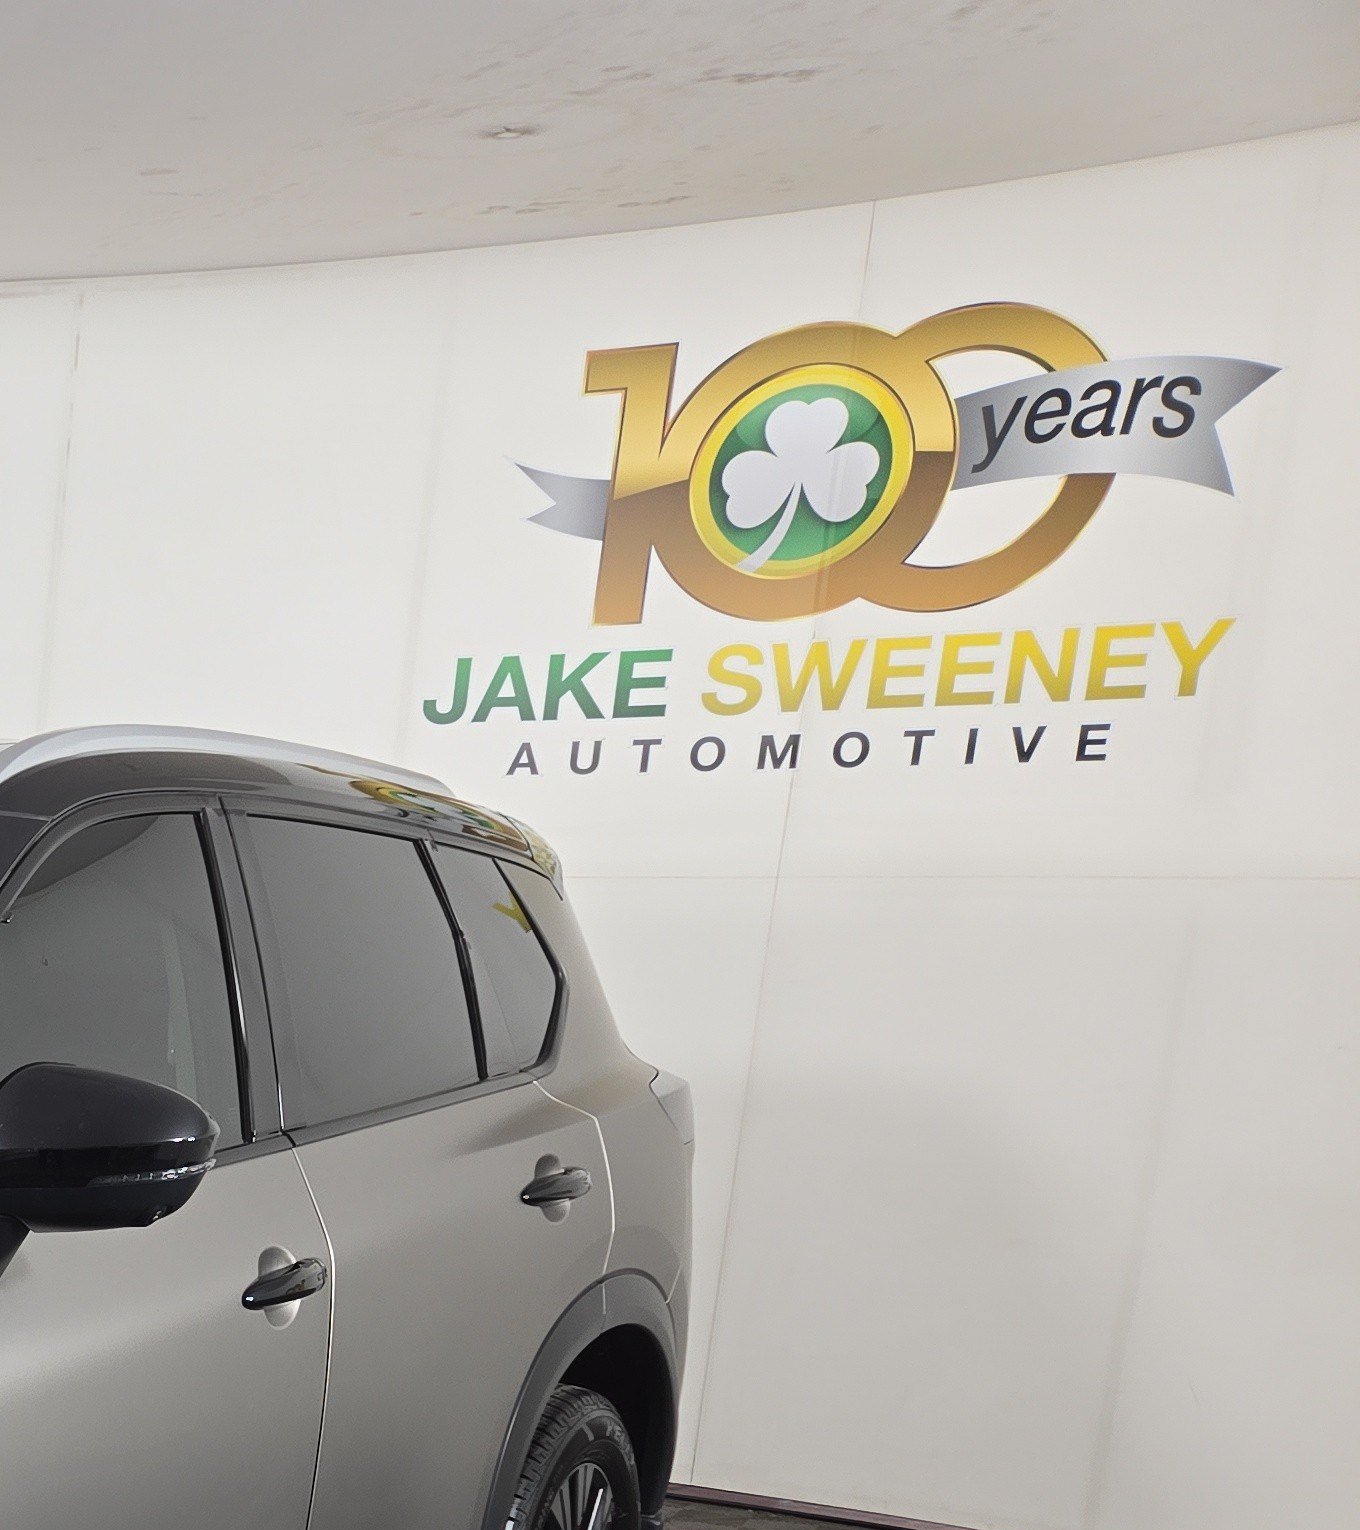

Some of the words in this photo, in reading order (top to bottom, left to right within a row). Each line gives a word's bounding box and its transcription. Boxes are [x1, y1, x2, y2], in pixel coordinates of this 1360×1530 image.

[583, 301, 1120, 628] 100
[971, 371, 1202, 474] years
[423, 647, 673, 725] JAKE
[701, 617, 1237, 717] SWEENEY
[506, 722, 1112, 777] AUTOMOTIVE
